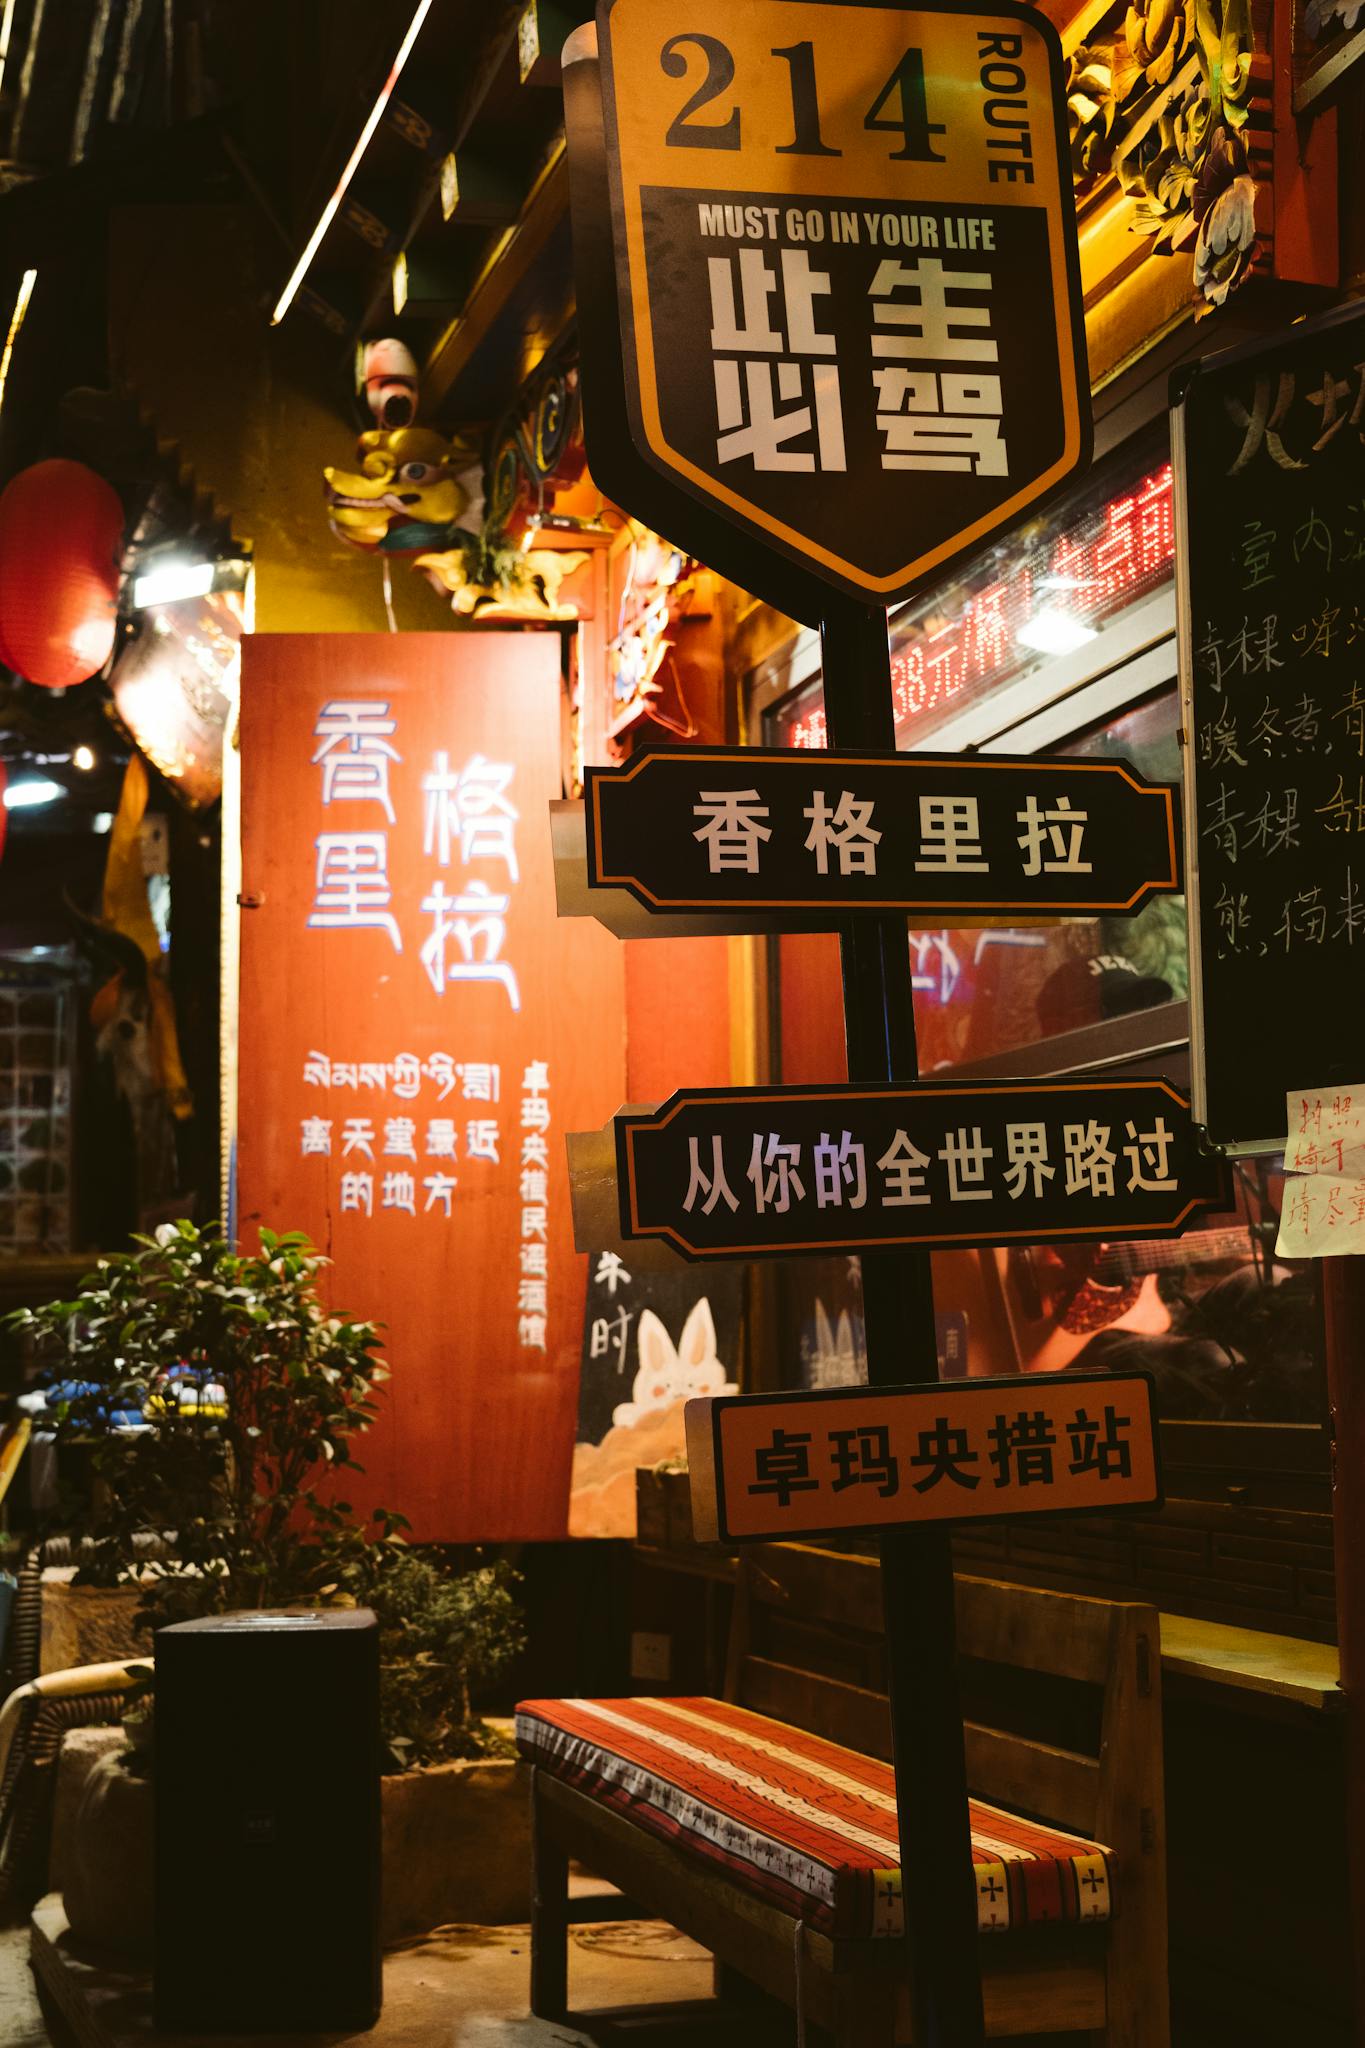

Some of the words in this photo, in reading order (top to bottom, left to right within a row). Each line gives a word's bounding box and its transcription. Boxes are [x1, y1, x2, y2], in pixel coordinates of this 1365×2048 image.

[659, 32, 947, 163] 214
[976, 31, 1035, 184] ROUTE
[698, 203, 780, 240] MUST
[786, 208, 824, 242] GO
[830, 211, 859, 244] IN
[864, 212, 939, 248] YOUR
[944, 217, 996, 250] LIFE
[706, 247, 999, 362] 此生
[712, 359, 1009, 477] 必驾
[692, 789, 1094, 876] 香格里拉
[300, 1115, 500, 1164] 离天堂最近
[681, 1117, 1179, 1216] 从你的全世界路过
[340, 1170, 458, 1219] 的地方
[747, 1405, 1133, 1507] 卓玛央措站
